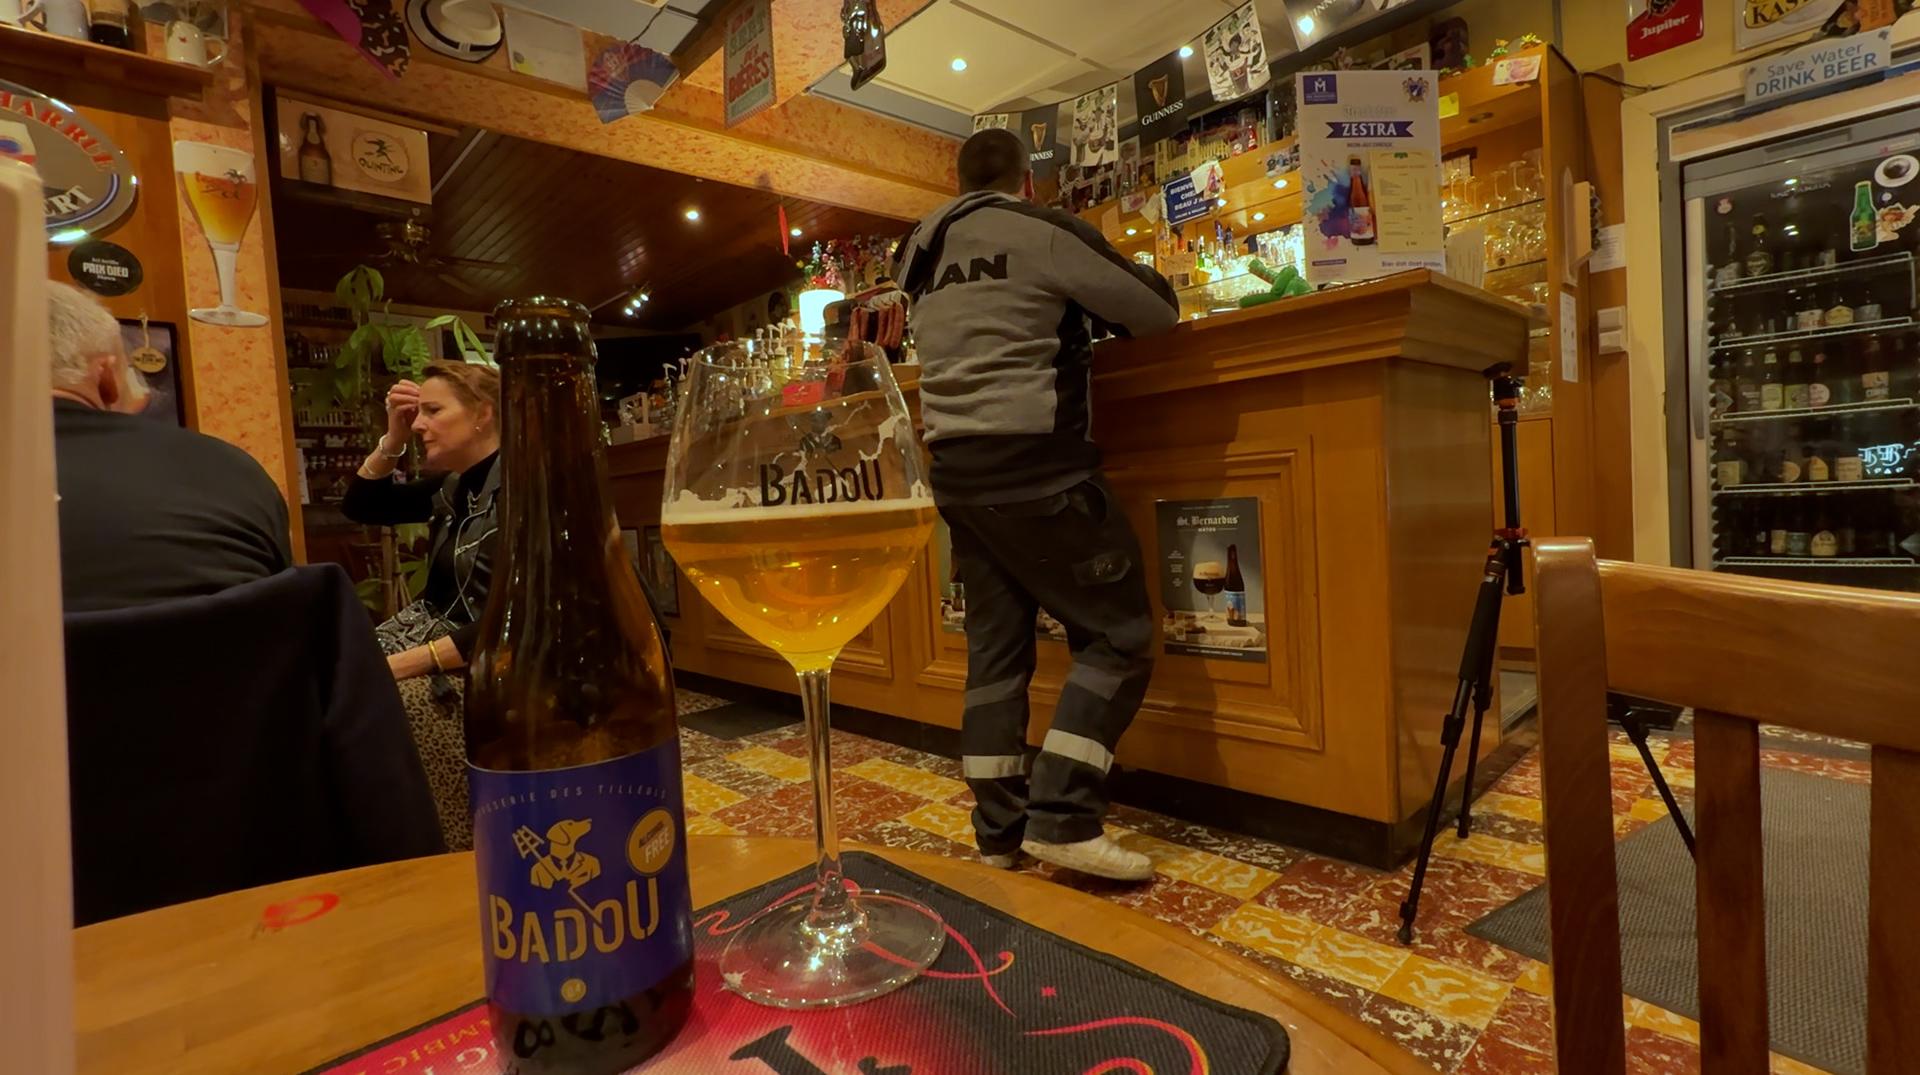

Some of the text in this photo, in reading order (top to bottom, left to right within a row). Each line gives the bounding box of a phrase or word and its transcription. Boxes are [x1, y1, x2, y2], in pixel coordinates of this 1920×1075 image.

[1752, 0, 1807, 25] KAS
[1640, 14, 1690, 40] Jupiler
[1768, 43, 1864, 78] Save Water
[1756, 53, 1877, 97] DRINK BEER
[1142, 100, 1184, 126] GUINNESS
[1342, 122, 1397, 137] ZESTRA
[1030, 150, 1054, 162] INNESS
[760, 458, 884, 507] BADOU
[1191, 514, 1239, 526] Bernardus
[550, 786, 584, 800] DES
[644, 826, 672, 864] FREE
[488, 876, 661, 963] BADOU
